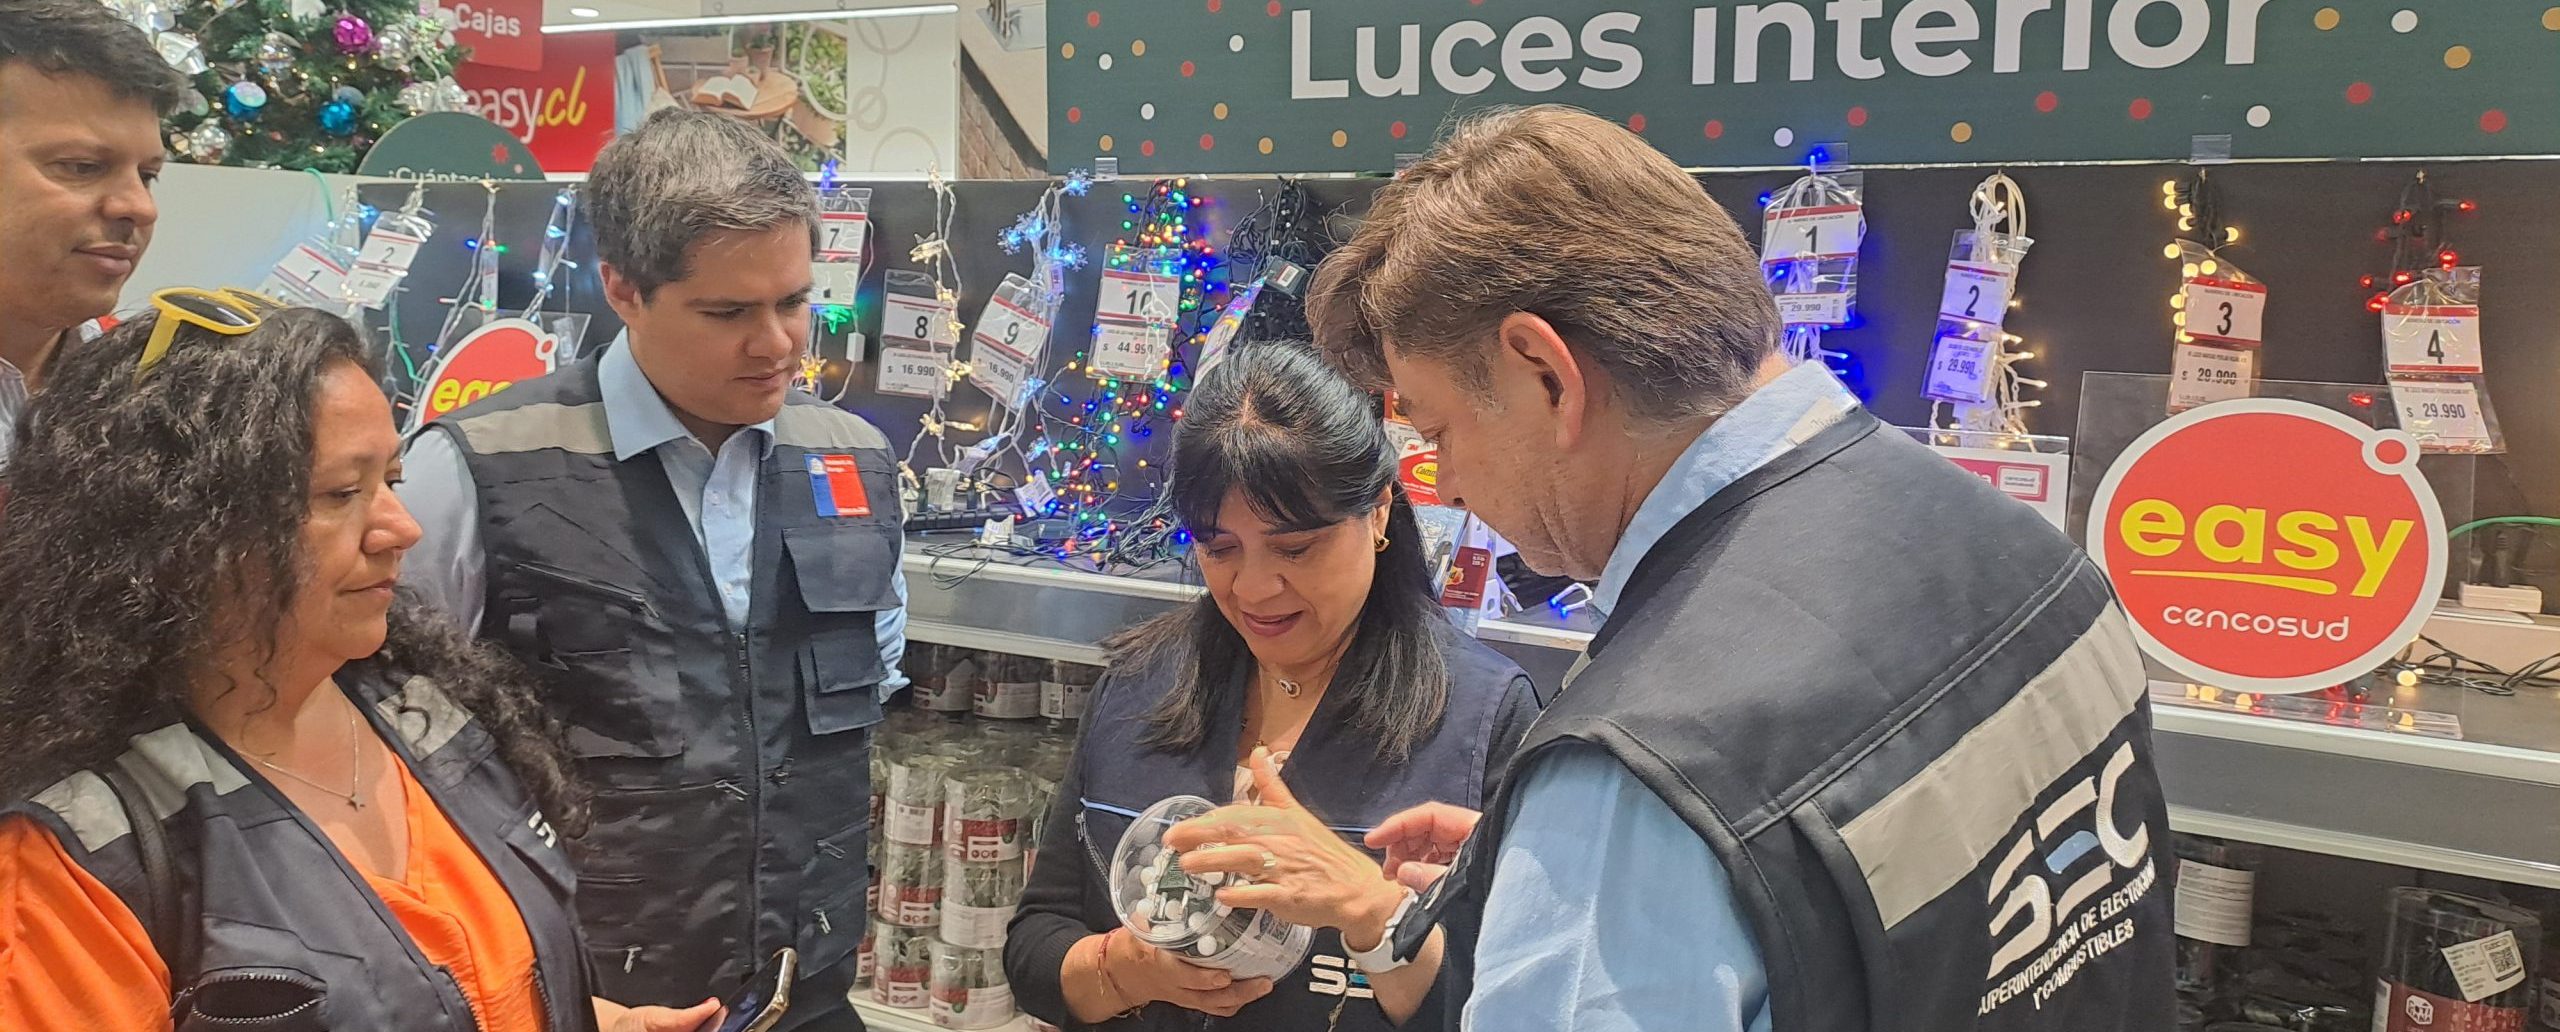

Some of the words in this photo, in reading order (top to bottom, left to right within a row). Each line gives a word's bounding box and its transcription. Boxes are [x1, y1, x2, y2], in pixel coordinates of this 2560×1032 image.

[455, 3, 521, 38] Cajas
[1291, 9, 1644, 99] Luces
[1692, 0, 2269, 85] interior
[829, 227, 841, 250] 7
[1805, 225, 1818, 255] 1
[381, 246, 395, 263] 2
[1126, 288, 1154, 316] 10
[1964, 284, 1980, 318] 2
[914, 315, 929, 340] 8
[2216, 301, 2233, 336] 3
[1003, 321, 1020, 346] 9
[2427, 329, 2445, 365] 4
[901, 363, 936, 377] 16.990
[988, 361, 1015, 384] 16.990
[2421, 402, 2466, 419] 29.990
[2119, 498, 2416, 599] easy
[2162, 604, 2350, 642] cencosud
[1986, 740, 2150, 981] SEC
[2080, 905, 2099, 934] DE
